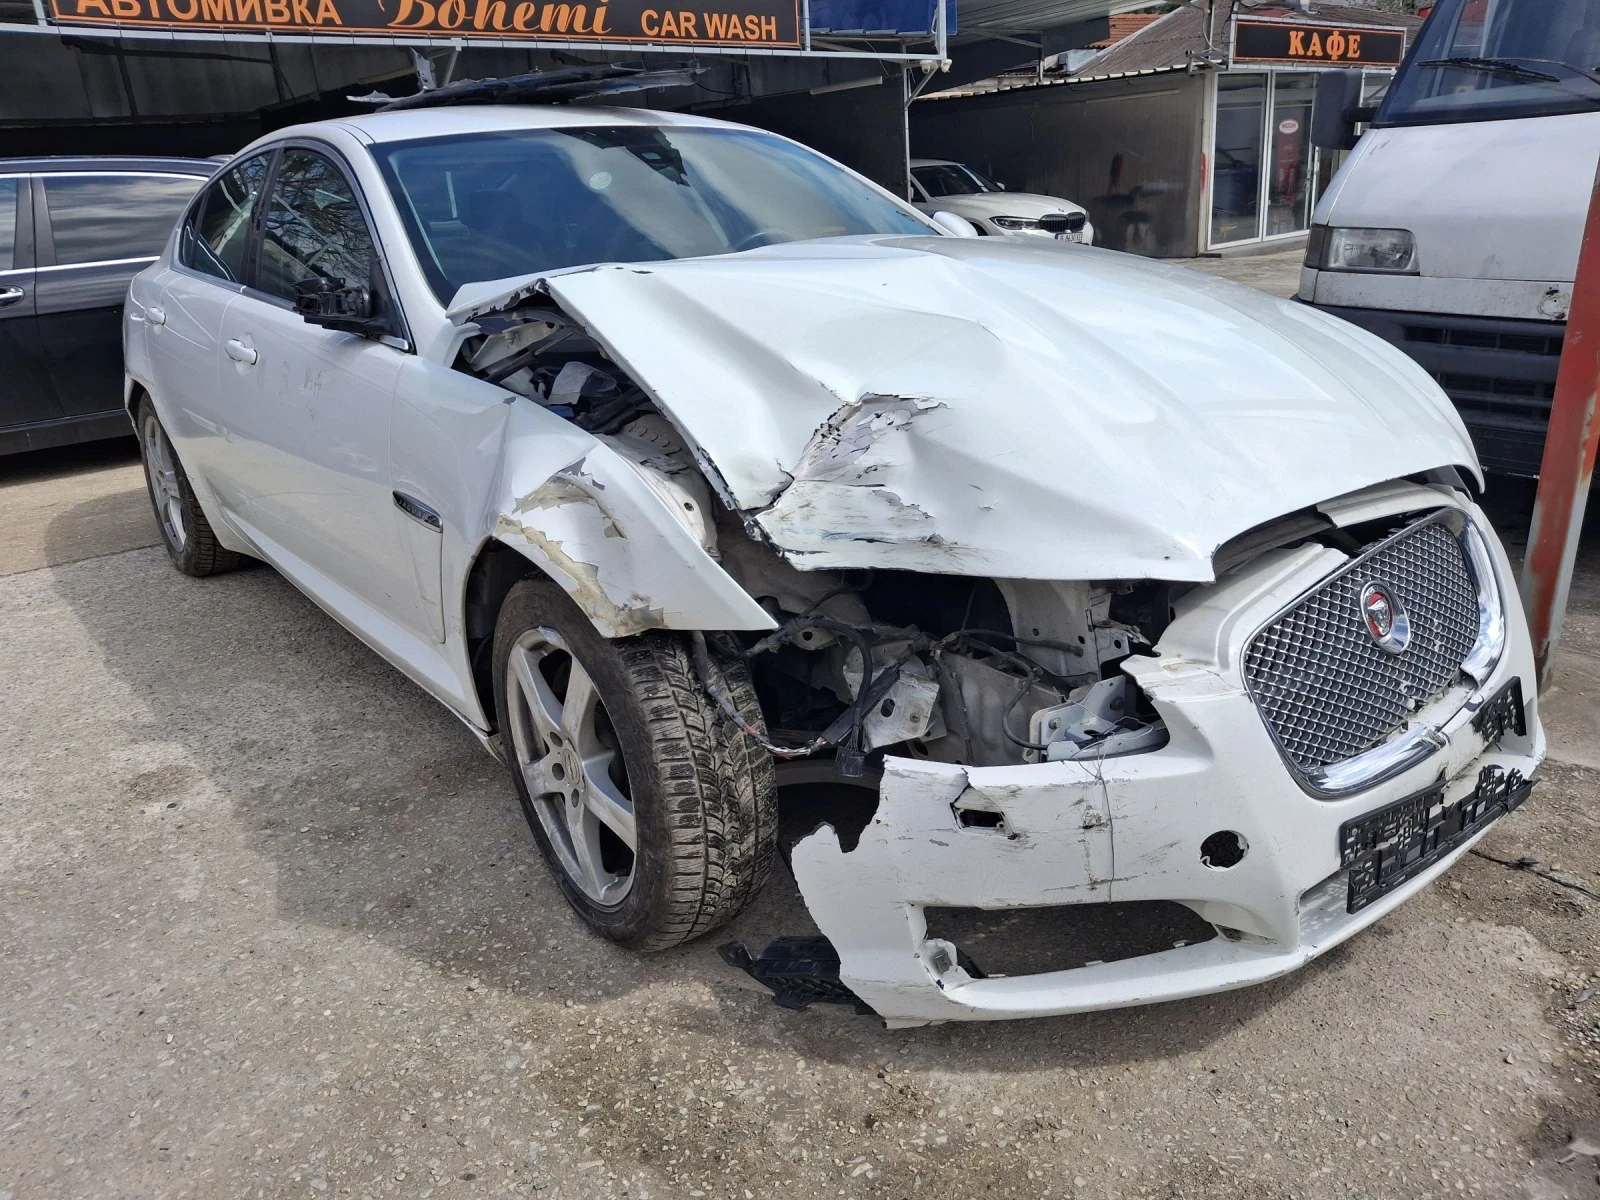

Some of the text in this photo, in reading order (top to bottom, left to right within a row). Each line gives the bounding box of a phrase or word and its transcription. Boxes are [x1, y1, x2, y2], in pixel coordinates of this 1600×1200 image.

[641, 9, 777, 41] CAR WASH
[1288, 30, 1361, 61] КАФЕ
[397, 497, 429, 521] JAGUAR
